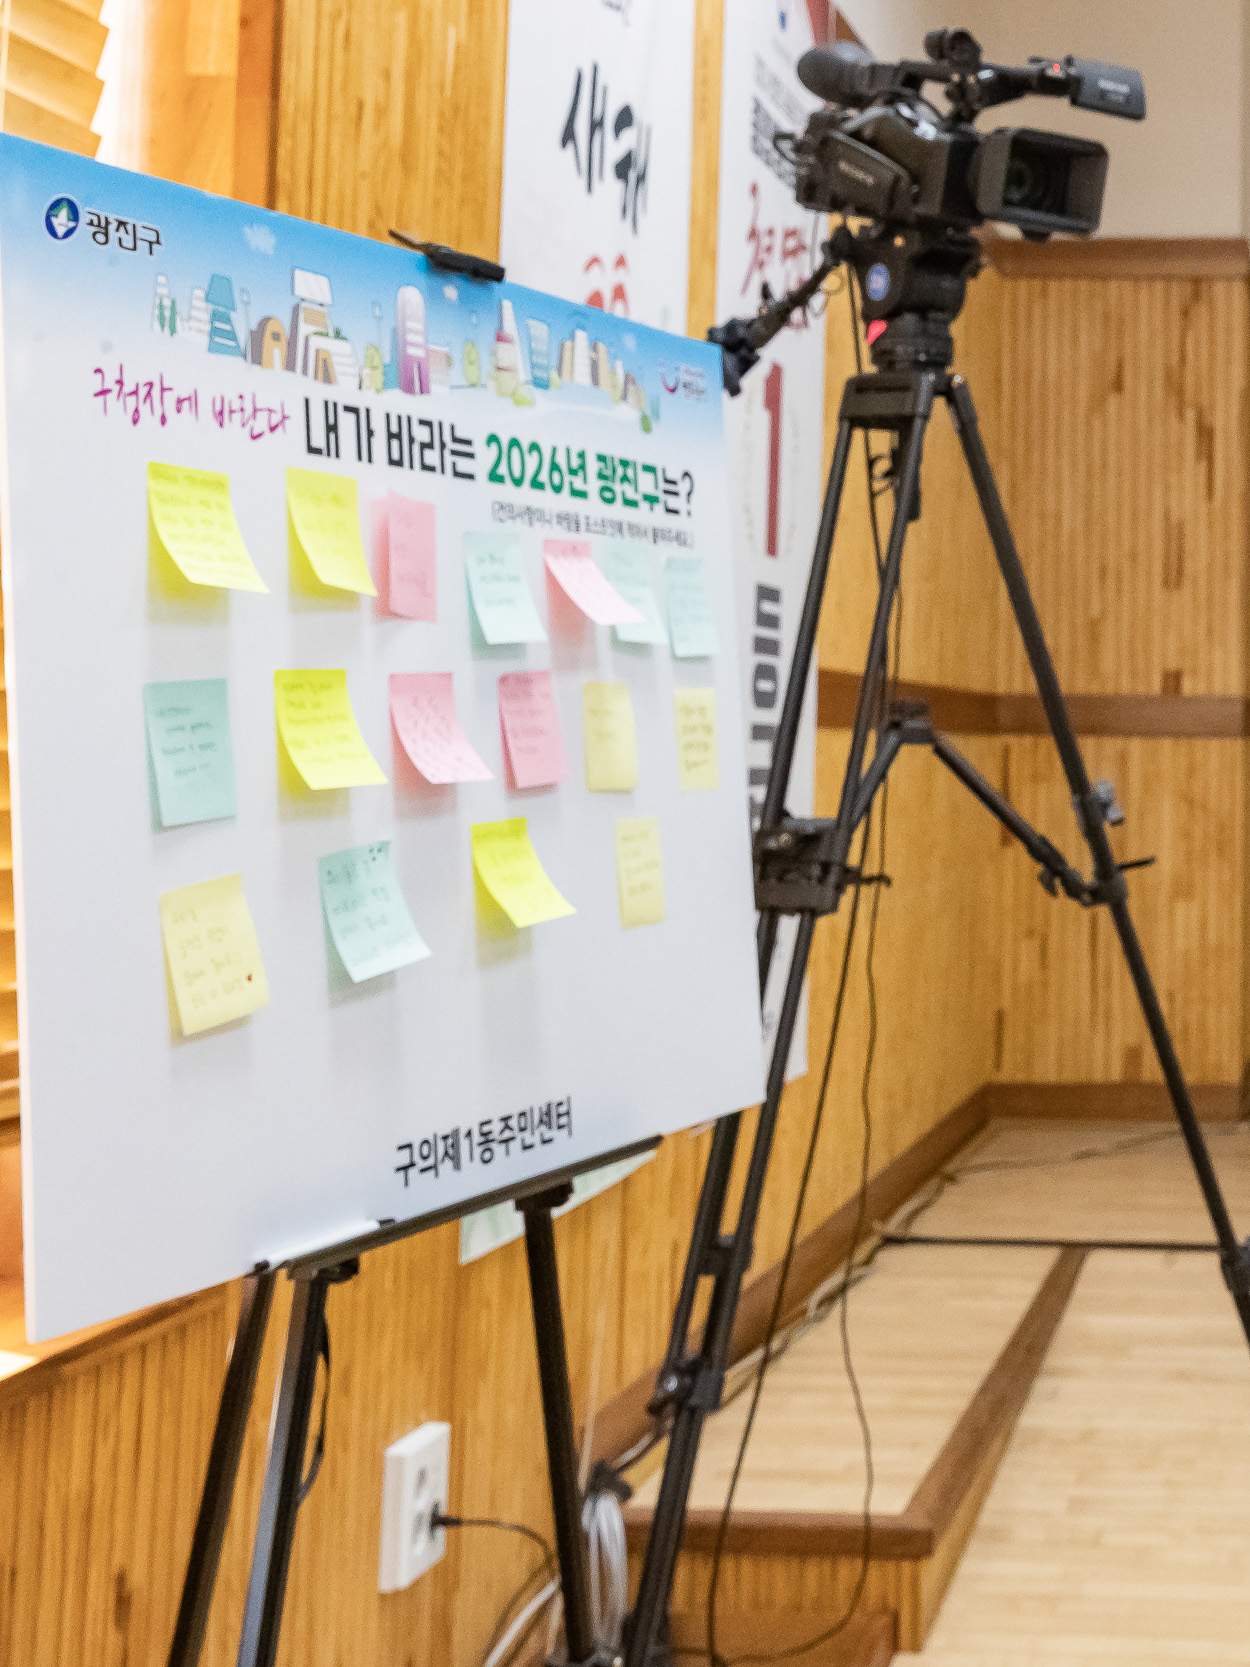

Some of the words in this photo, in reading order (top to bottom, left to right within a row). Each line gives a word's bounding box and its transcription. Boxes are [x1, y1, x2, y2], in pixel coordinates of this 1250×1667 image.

[85, 211, 162, 256] 광진구
[93, 363, 199, 427] 구청장에
[212, 391, 291, 441] 바란다
[304, 396, 374, 464] 내가
[386, 412, 476, 480] 바라는
[486, 432, 588, 500] 2026년
[596, 452, 695, 518] 광진구는?
[395, 1096, 573, 1188] 구의제1동주민센터
